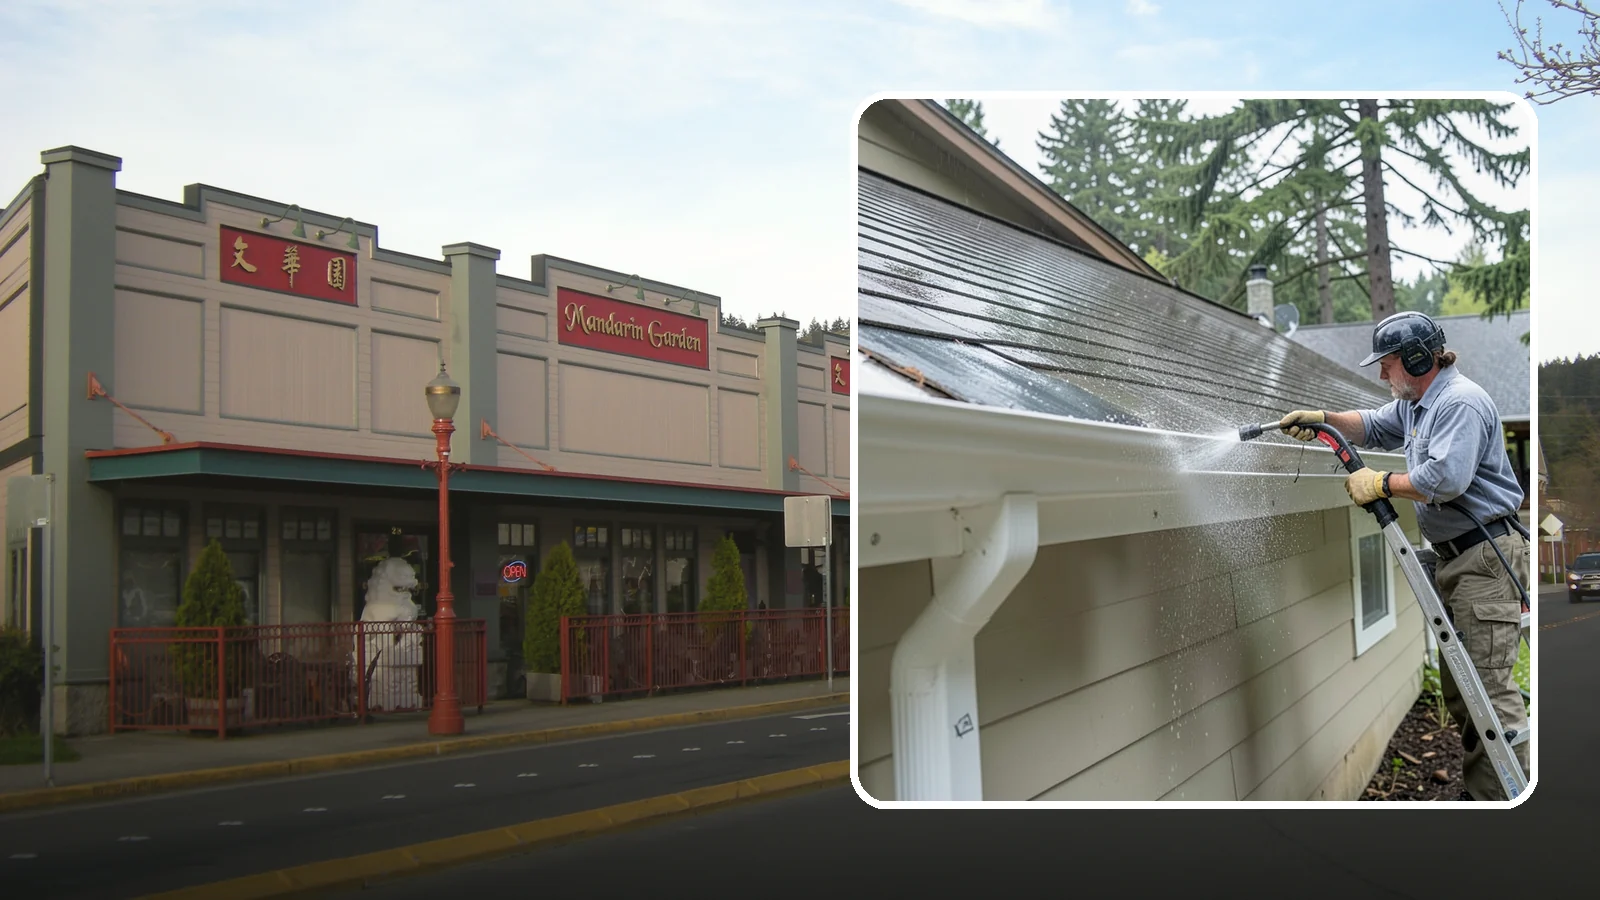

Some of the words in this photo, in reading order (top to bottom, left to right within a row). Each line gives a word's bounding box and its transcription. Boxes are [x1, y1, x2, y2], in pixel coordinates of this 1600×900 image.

[231, 235, 346, 291] 文華園
[564, 302, 644, 335] Mandarin
[647, 320, 702, 352] Garden
[503, 565, 527, 578] OPEN
